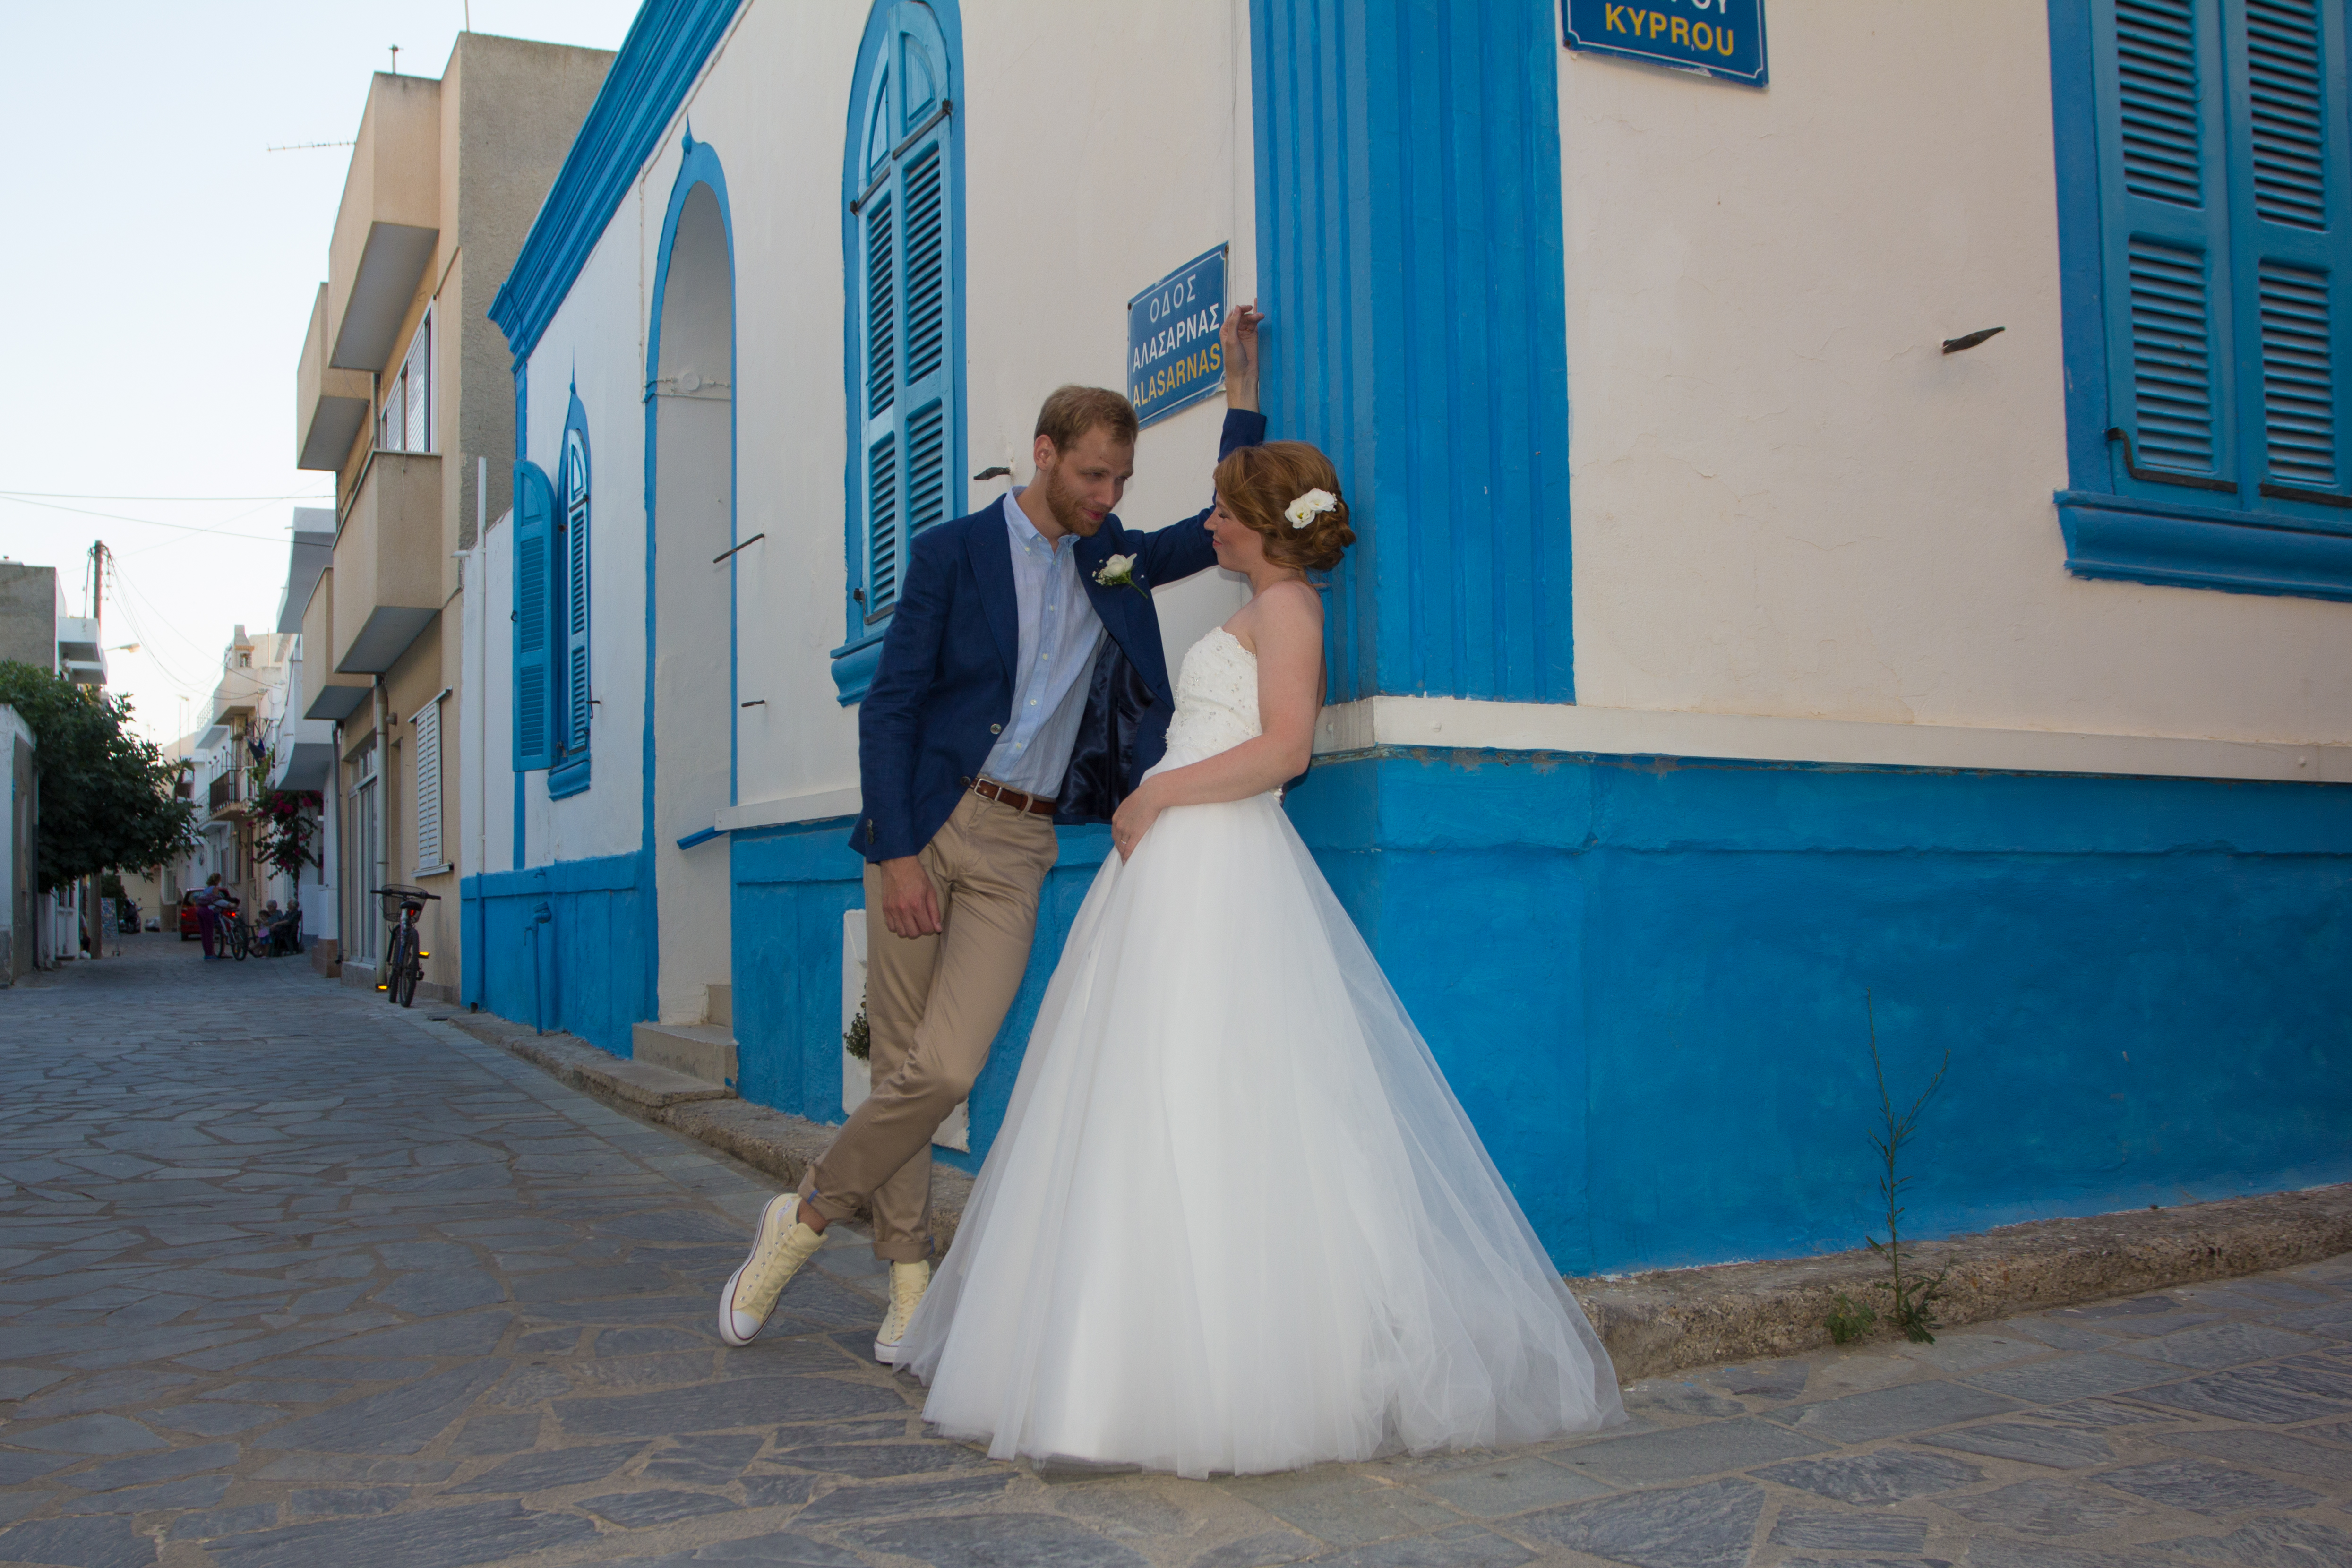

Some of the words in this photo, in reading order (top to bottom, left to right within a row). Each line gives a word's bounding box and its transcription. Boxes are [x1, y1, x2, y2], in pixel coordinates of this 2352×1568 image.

[1605, 3, 1734, 56] KYPROU
[1150, 274, 1196, 323] ΟΔΟΣ
[1133, 303, 1219, 373] ΑΛΑΣΑΡΝΑΣ
[1133, 343, 1221, 409] ALASARNAS
